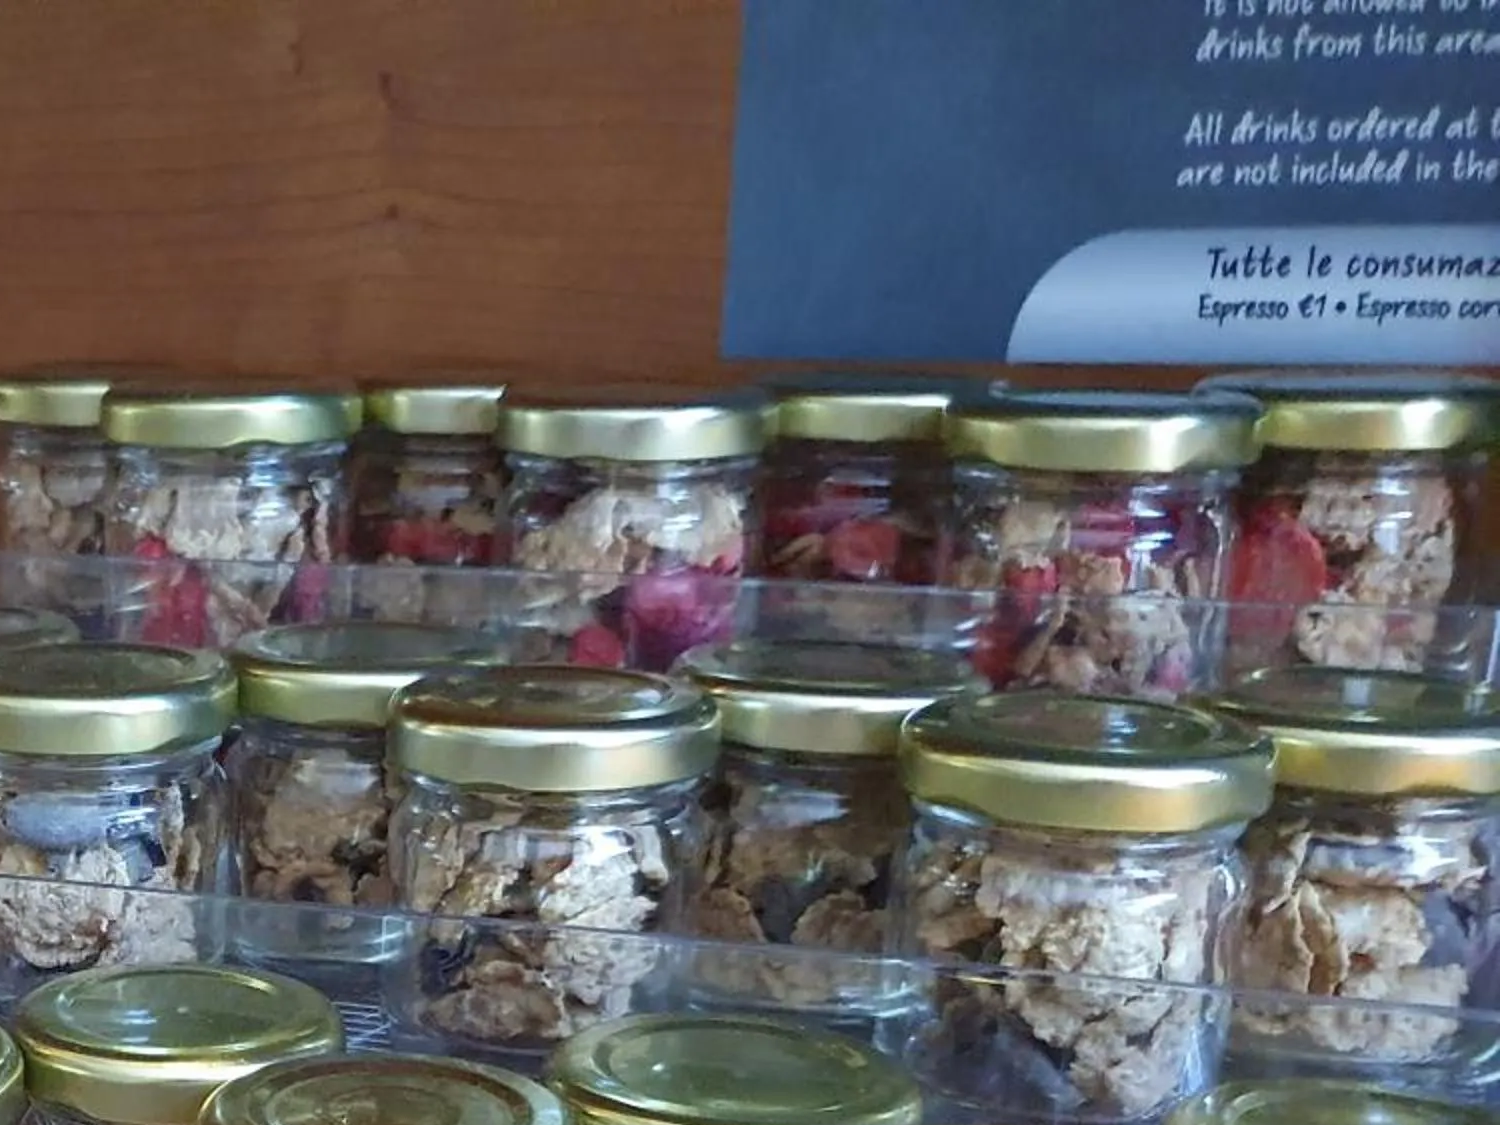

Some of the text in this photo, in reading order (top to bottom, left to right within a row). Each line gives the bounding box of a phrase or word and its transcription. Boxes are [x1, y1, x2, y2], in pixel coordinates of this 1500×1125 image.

[1196, 24, 1285, 62] drinks
[1294, 22, 1363, 60] from
[1373, 22, 1428, 57] this
[1184, 111, 1224, 147] All
[1230, 108, 1318, 146] drinks
[1326, 105, 1441, 143] ordered
[1444, 106, 1479, 140] at
[1176, 161, 1225, 187] are
[1234, 152, 1282, 186] not
[1291, 147, 1410, 185] included
[1415, 151, 1441, 183] in
[1206, 244, 1292, 280] Tutte
[1307, 244, 1333, 280] le
[1198, 293, 1290, 328] Espresso
[1297, 293, 1328, 320] €1
[1356, 291, 1452, 328] Espresso
